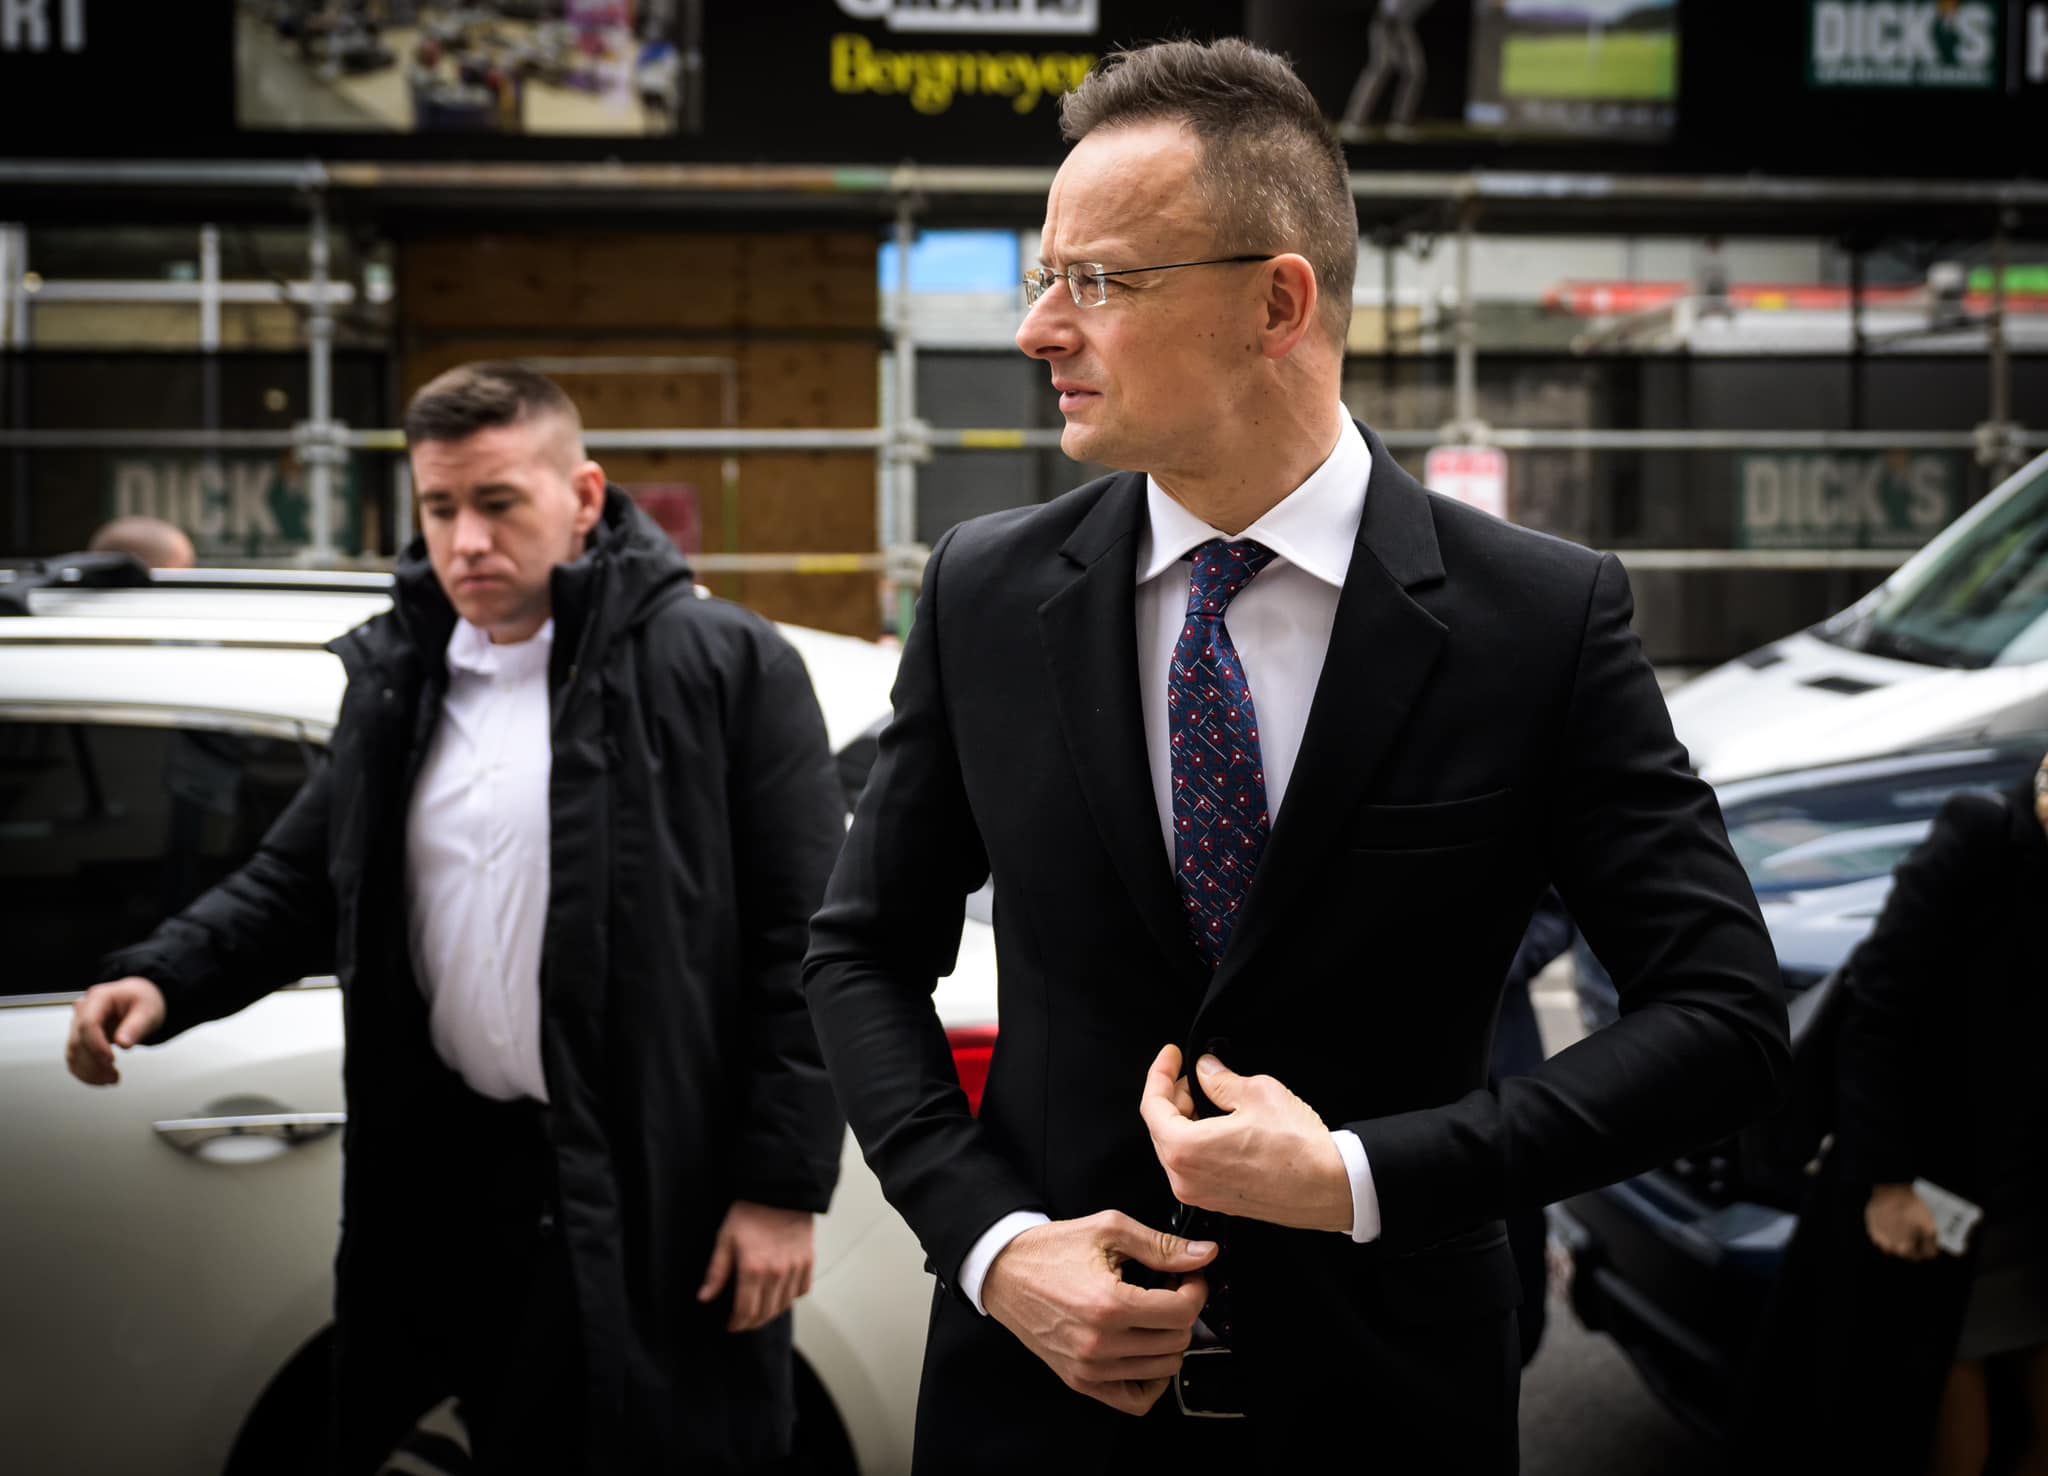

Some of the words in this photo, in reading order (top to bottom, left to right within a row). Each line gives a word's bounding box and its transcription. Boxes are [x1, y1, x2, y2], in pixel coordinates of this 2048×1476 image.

[1812, 1, 1993, 63] DICK'S
[830, 33, 1097, 114] Bergmeyer
[1744, 456, 1950, 526] DICK'S
